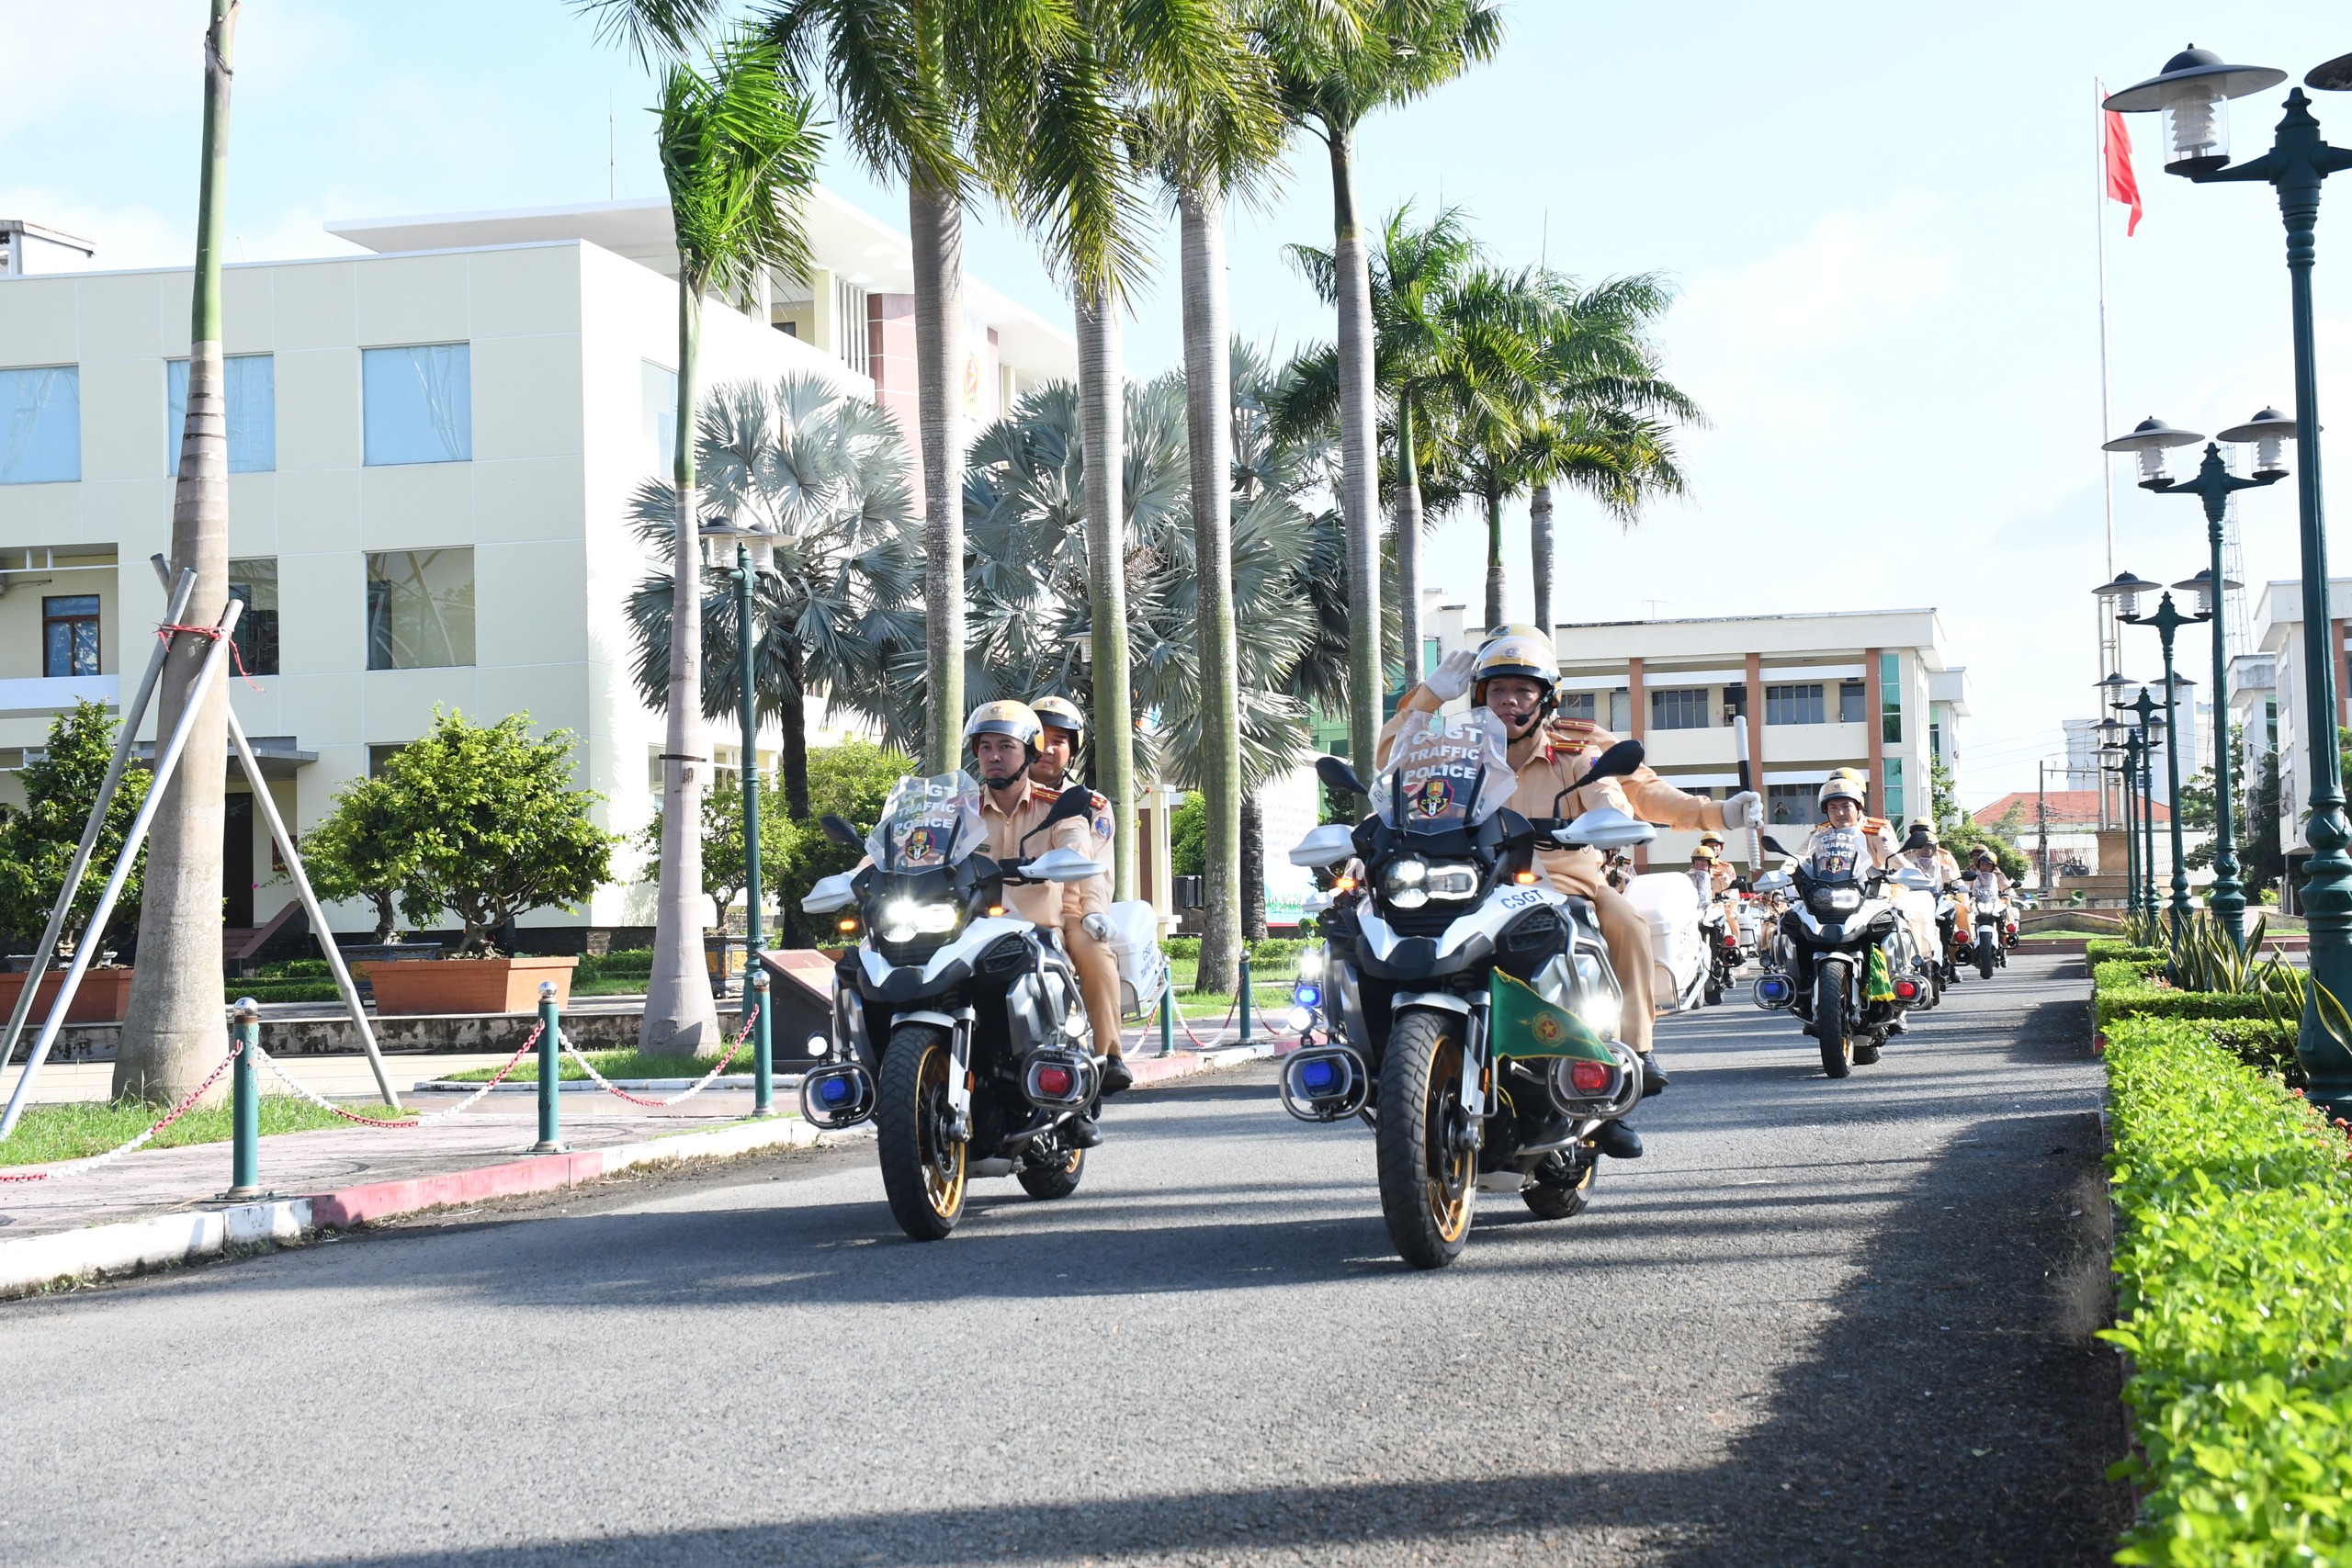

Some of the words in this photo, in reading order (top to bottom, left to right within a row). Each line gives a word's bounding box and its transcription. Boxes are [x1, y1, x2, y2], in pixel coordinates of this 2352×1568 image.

[1412, 726, 1483, 745] CSGT
[1409, 745, 1480, 762] TRAFFIC
[1404, 764, 1477, 783] POLICE
[901, 784, 958, 803] CSGT
[898, 801, 956, 818] TRAFFIC
[894, 818, 954, 833] POLICE
[1819, 832, 1856, 842] CSGT
[1820, 842, 1855, 851] TRAFFIC
[1818, 851, 1853, 860] POLICE
[1500, 889, 1544, 909] CSGT
